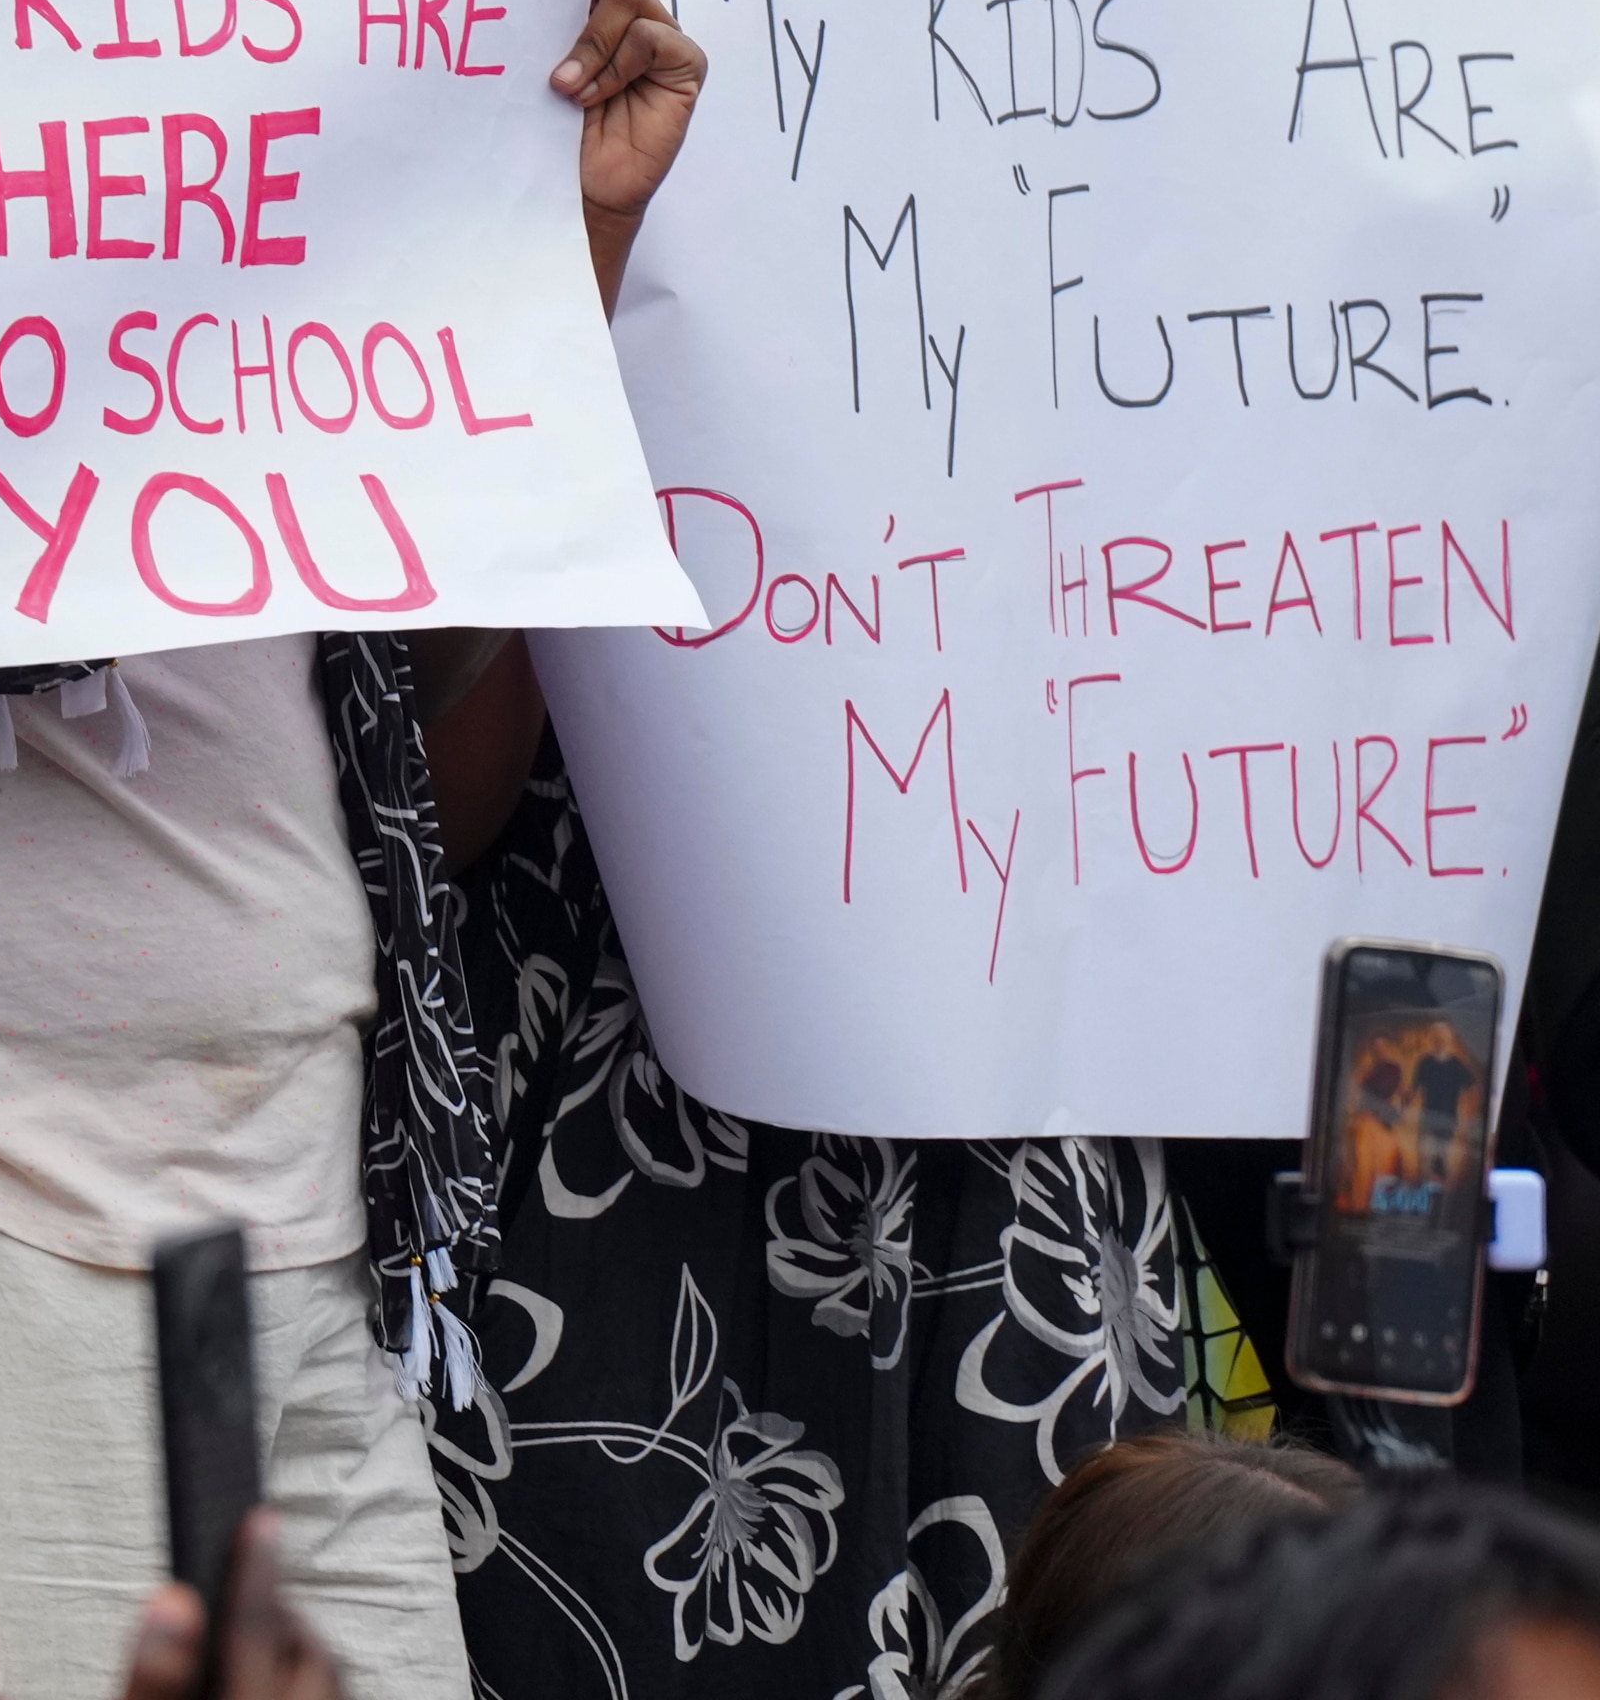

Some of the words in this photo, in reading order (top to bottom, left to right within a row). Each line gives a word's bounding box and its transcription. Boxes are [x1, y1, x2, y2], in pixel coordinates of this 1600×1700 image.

[102, 311, 534, 436] SCHOOL
[650, 486, 966, 652] DON'T
[1014, 478, 1518, 646] THREATEN
